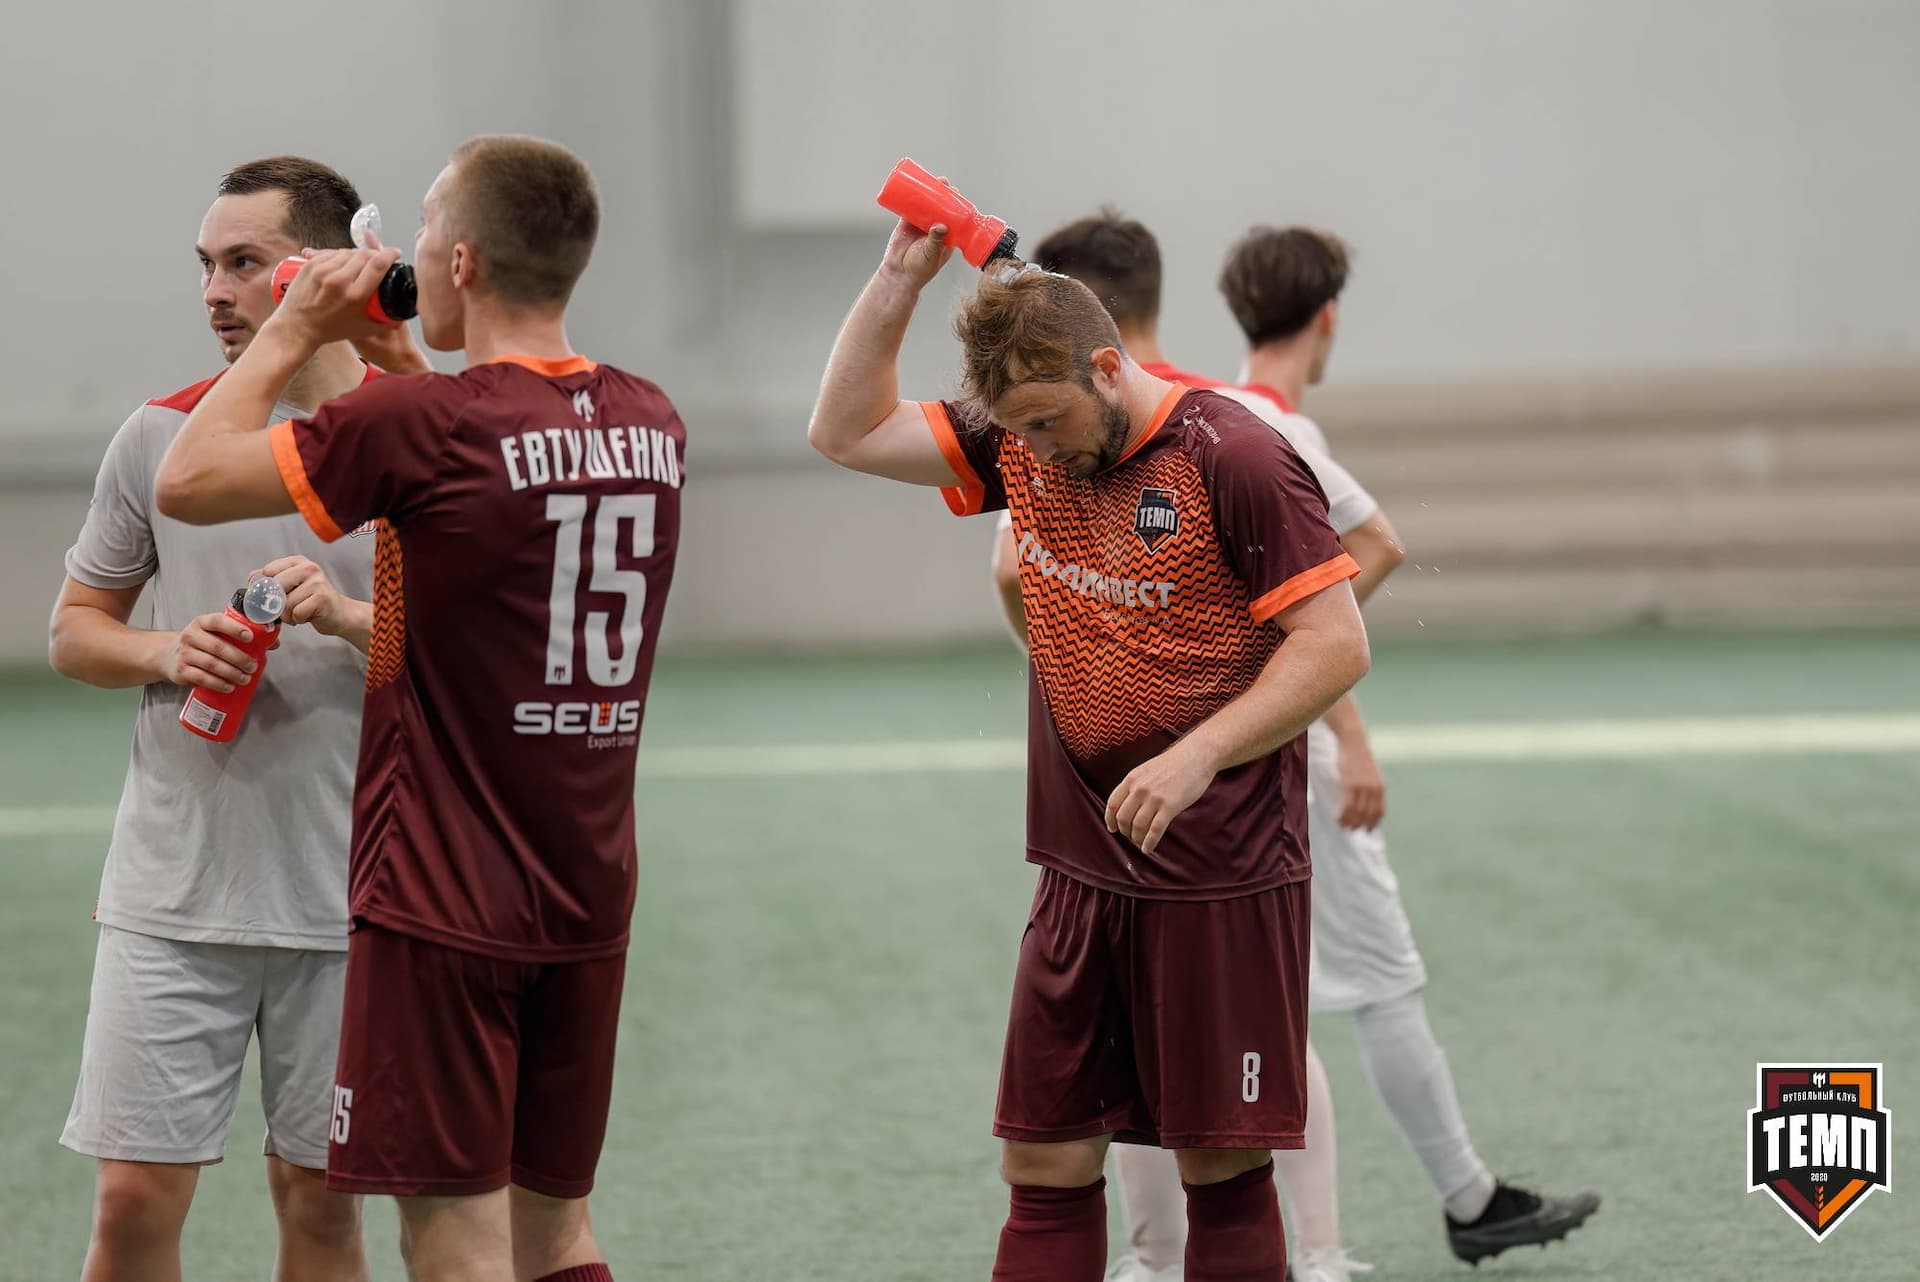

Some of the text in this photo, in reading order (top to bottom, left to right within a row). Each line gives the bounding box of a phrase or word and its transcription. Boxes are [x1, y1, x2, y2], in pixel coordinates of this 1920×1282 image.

[500, 426, 680, 491] ЕВТУШЕНКО
[1139, 506, 1176, 531] ТЕМП
[545, 494, 656, 687] 15
[513, 700, 640, 735] SEUS
[1242, 1051, 1261, 1103] 8
